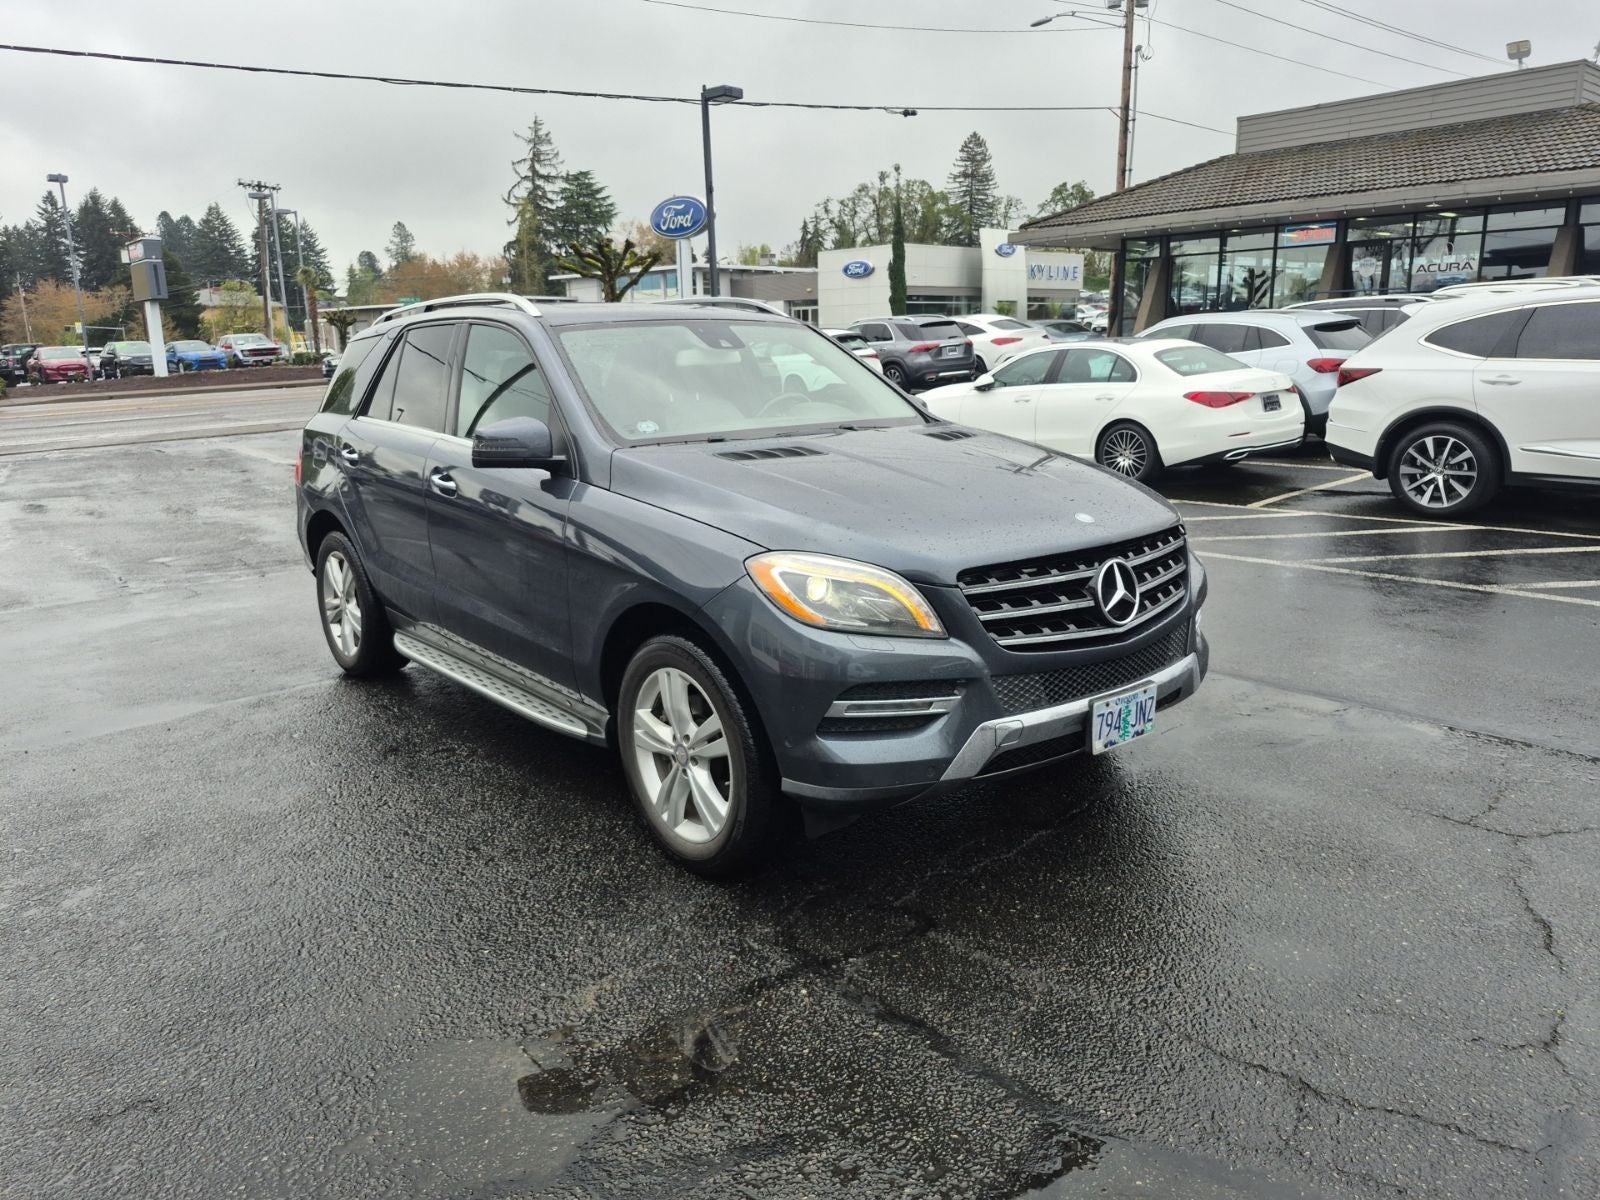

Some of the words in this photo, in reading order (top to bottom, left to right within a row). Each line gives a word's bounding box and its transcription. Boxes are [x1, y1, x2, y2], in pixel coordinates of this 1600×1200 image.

[660, 204, 694, 231] Ford
[847, 263, 866, 275] Ford
[1029, 264, 1079, 280] KYLINE
[1415, 261, 1474, 274] ACURA
[1096, 707, 1122, 741] 794
[1131, 696, 1154, 728] JNZ
